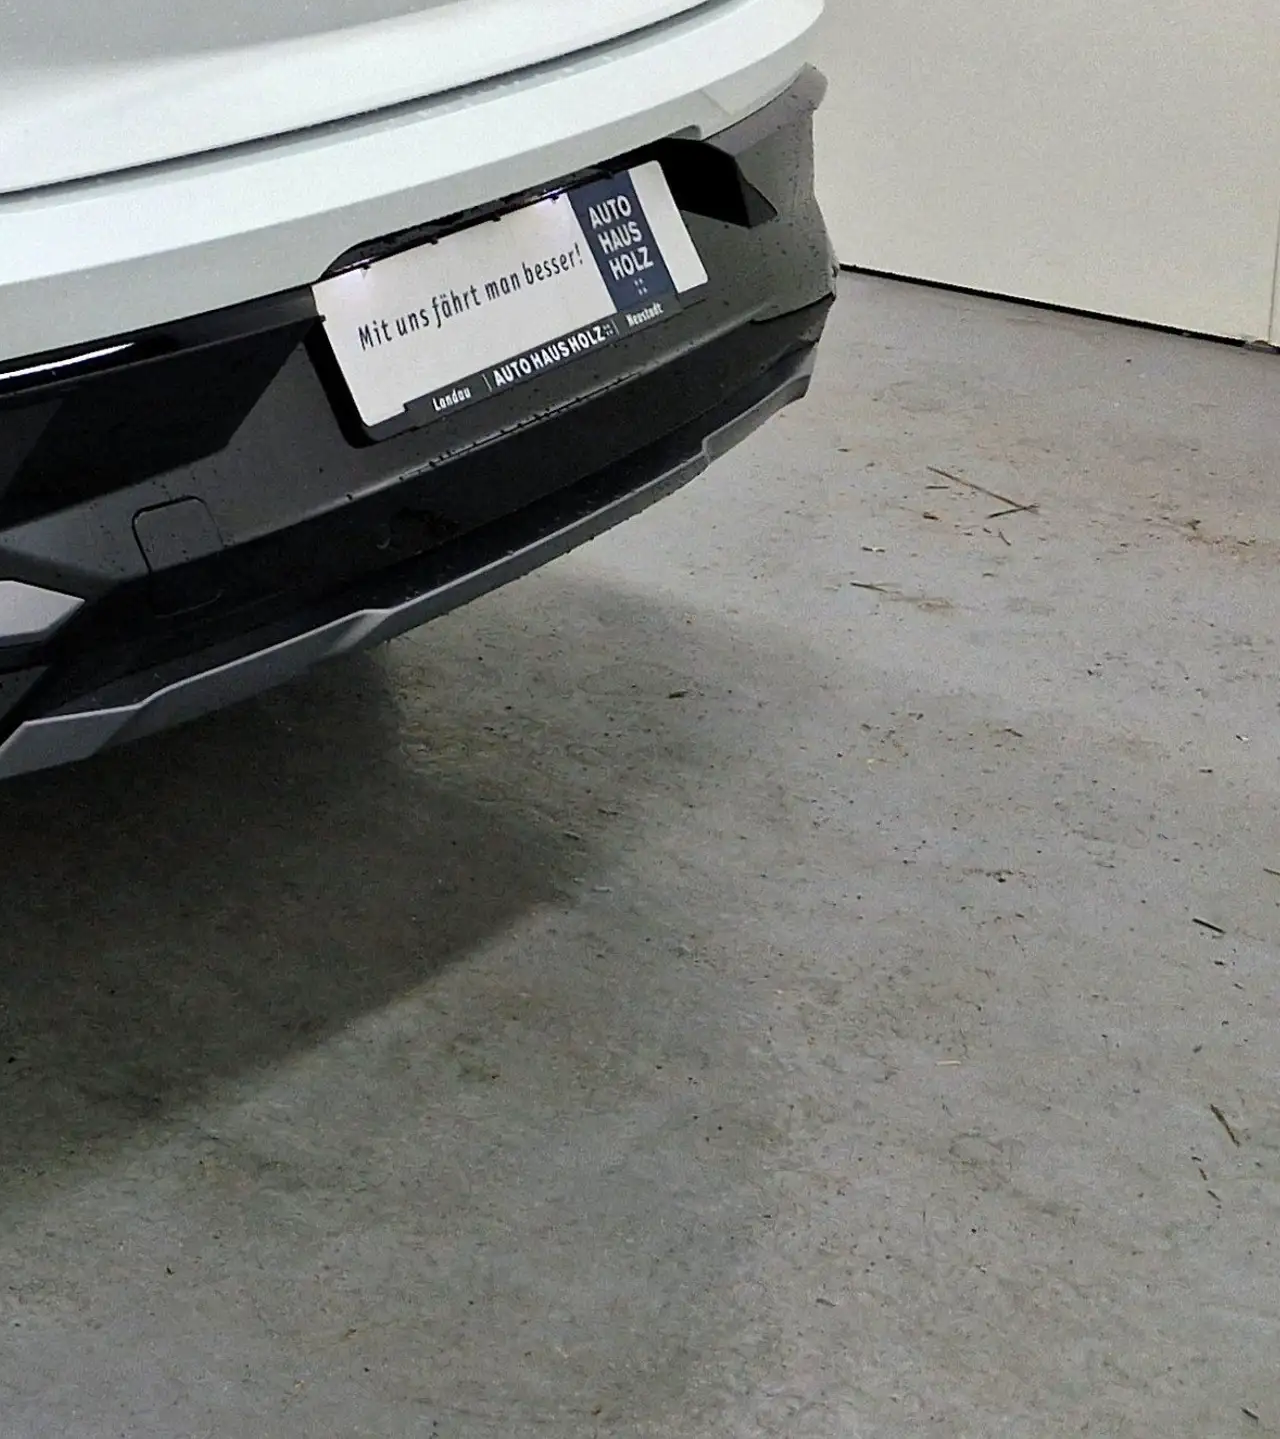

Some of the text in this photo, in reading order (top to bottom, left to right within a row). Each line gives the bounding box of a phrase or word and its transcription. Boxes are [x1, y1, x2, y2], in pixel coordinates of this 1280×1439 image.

[588, 195, 632, 229] AUTO
[597, 221, 643, 254] HAUS
[608, 246, 654, 280] HOLZ
[358, 242, 583, 351] Mit uns fährt man besser!
[432, 387, 472, 411] Landau
[567, 325, 606, 353] HOLZ
